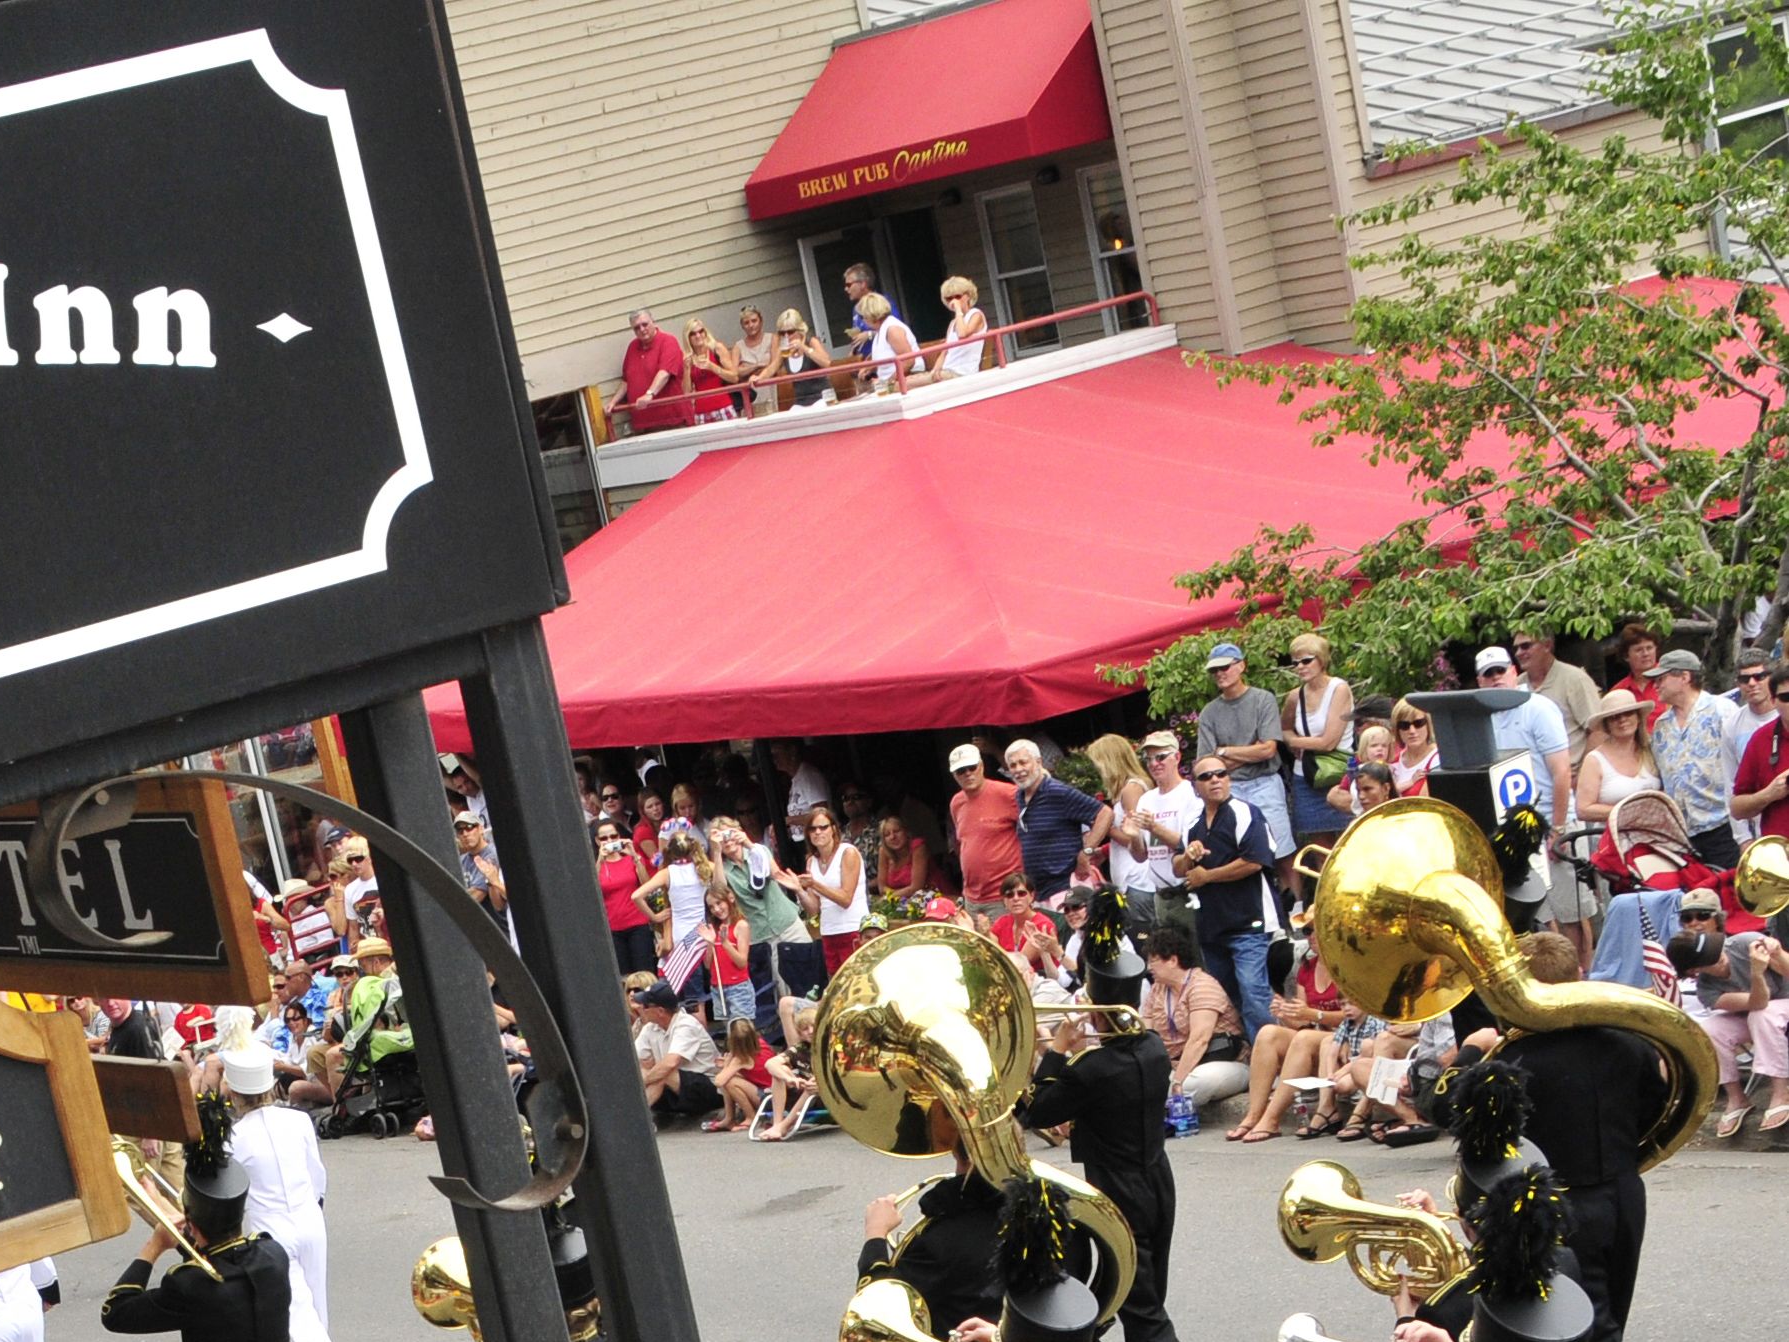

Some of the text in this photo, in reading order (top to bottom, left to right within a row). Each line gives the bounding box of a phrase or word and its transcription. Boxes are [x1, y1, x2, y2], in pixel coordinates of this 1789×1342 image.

[798, 140, 968, 198] BREW PUB Cantina
[1505, 774, 1527, 807] P
[17, 935, 40, 955] TMI
